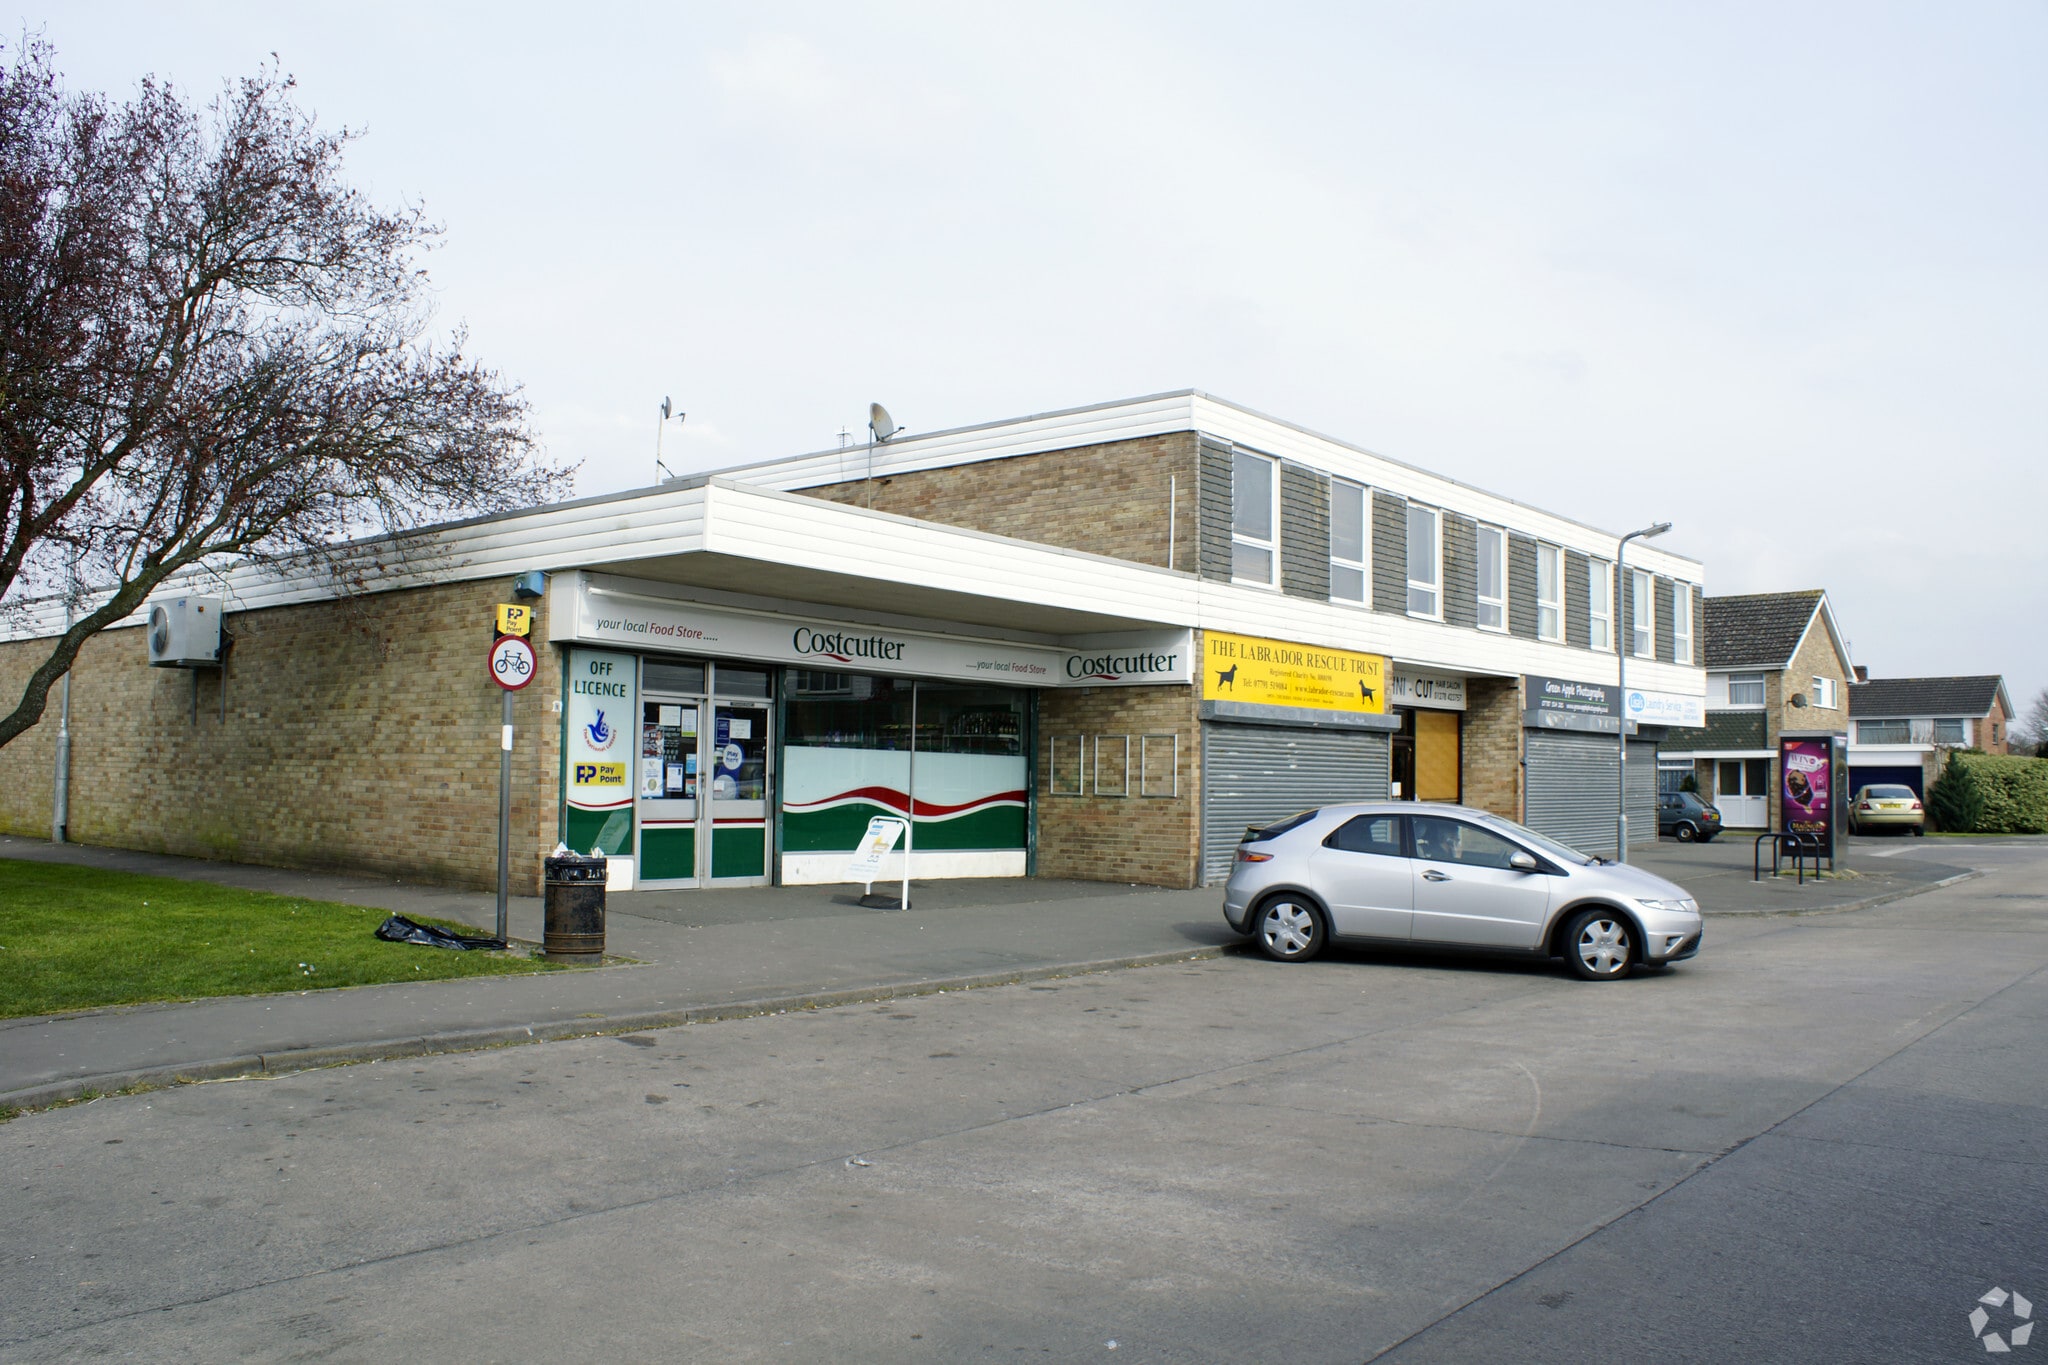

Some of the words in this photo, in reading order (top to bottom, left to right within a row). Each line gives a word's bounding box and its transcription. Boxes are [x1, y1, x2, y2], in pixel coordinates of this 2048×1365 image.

[506, 624, 522, 633] Point
[597, 619, 621, 630] your
[623, 619, 648, 633] local
[650, 623, 674, 636] Food
[793, 627, 905, 660] Costcutter
[1066, 653, 1177, 678] Costcutter
[1211, 640, 1236, 657] THE
[1240, 644, 1303, 666] LABRADOR
[1306, 653, 1347, 671] RESCUE
[1350, 659, 1378, 676] TRUST
[590, 661, 613, 676] OFF
[994, 660, 1010, 671] local
[1012, 662, 1027, 673] Food
[1028, 664, 1046, 674] Store
[574, 680, 626, 697] LICENCE
[1415, 678, 1433, 698] CUT
[1545, 681, 1560, 693] Green
[1562, 683, 1575, 698] Apple
[1576, 684, 1605, 702] Photography
[600, 766, 614, 774] Pay
[600, 775, 622, 783] Point
